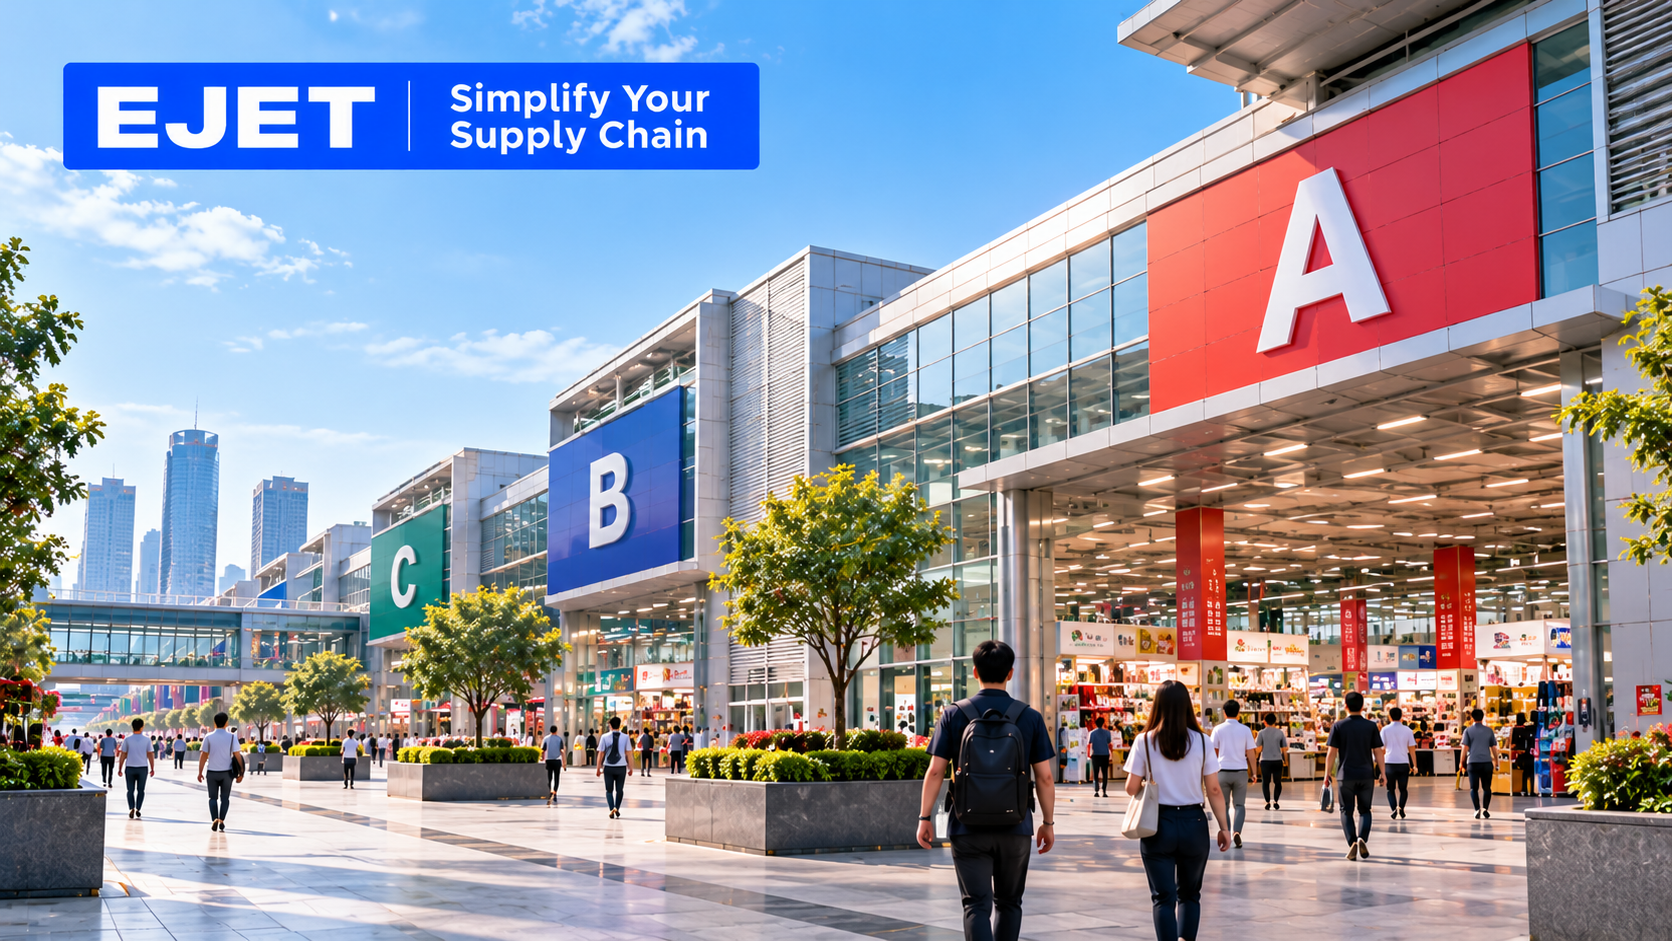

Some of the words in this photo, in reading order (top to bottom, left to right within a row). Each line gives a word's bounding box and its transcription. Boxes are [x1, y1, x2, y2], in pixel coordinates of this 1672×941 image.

[1256, 167, 1391, 353] A
[589, 452, 631, 550] B
[390, 545, 417, 609] C
